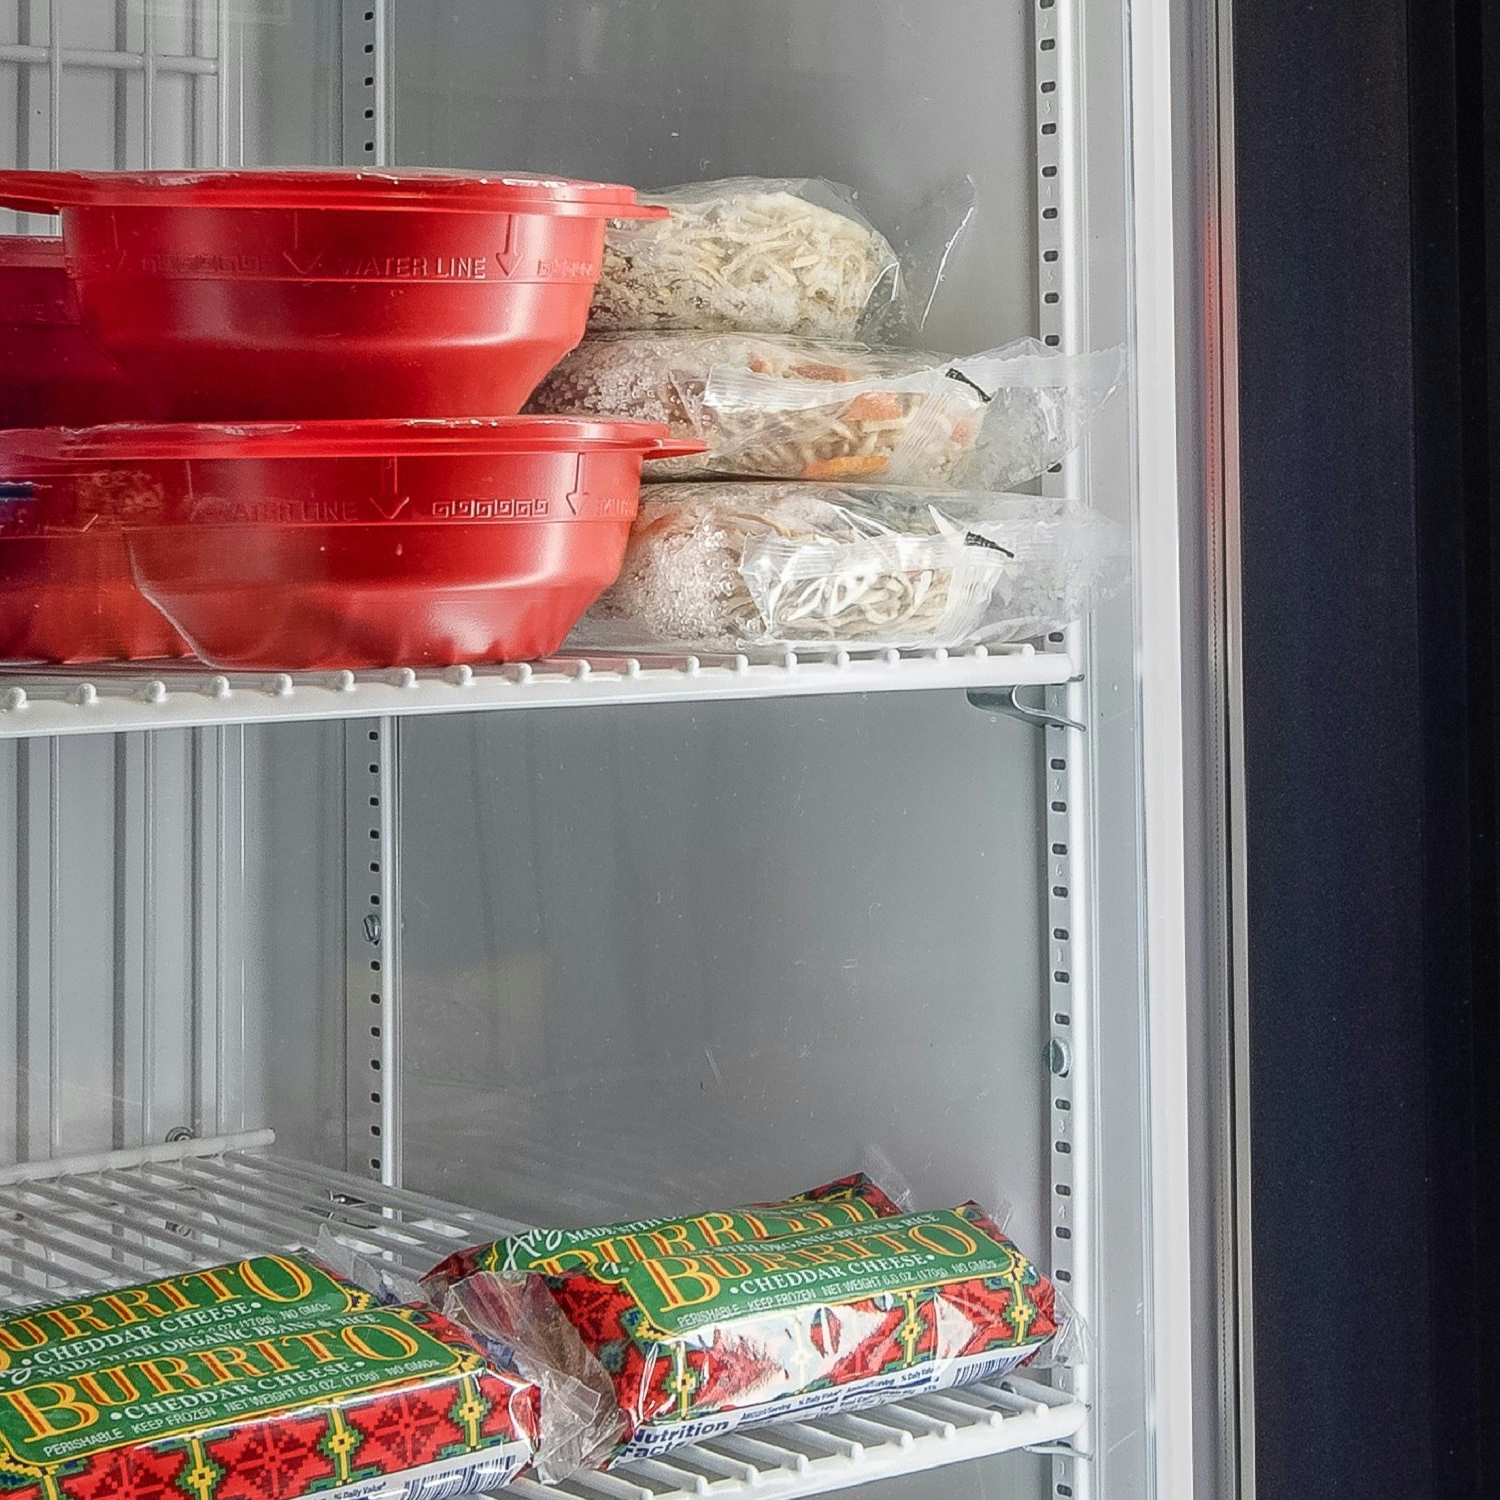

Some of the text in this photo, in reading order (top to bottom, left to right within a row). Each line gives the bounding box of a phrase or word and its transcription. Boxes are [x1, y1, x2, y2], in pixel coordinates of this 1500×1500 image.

[435, 257, 485, 279] LINE
[644, 1218, 979, 1313] BURRITO
[739, 1252, 928, 1296] CHEDDAR CHEESE
[676, 1276, 882, 1328] PERISHABLE KEEP FROZEN NET WEIGHT
[33, 1301, 250, 1366] CHEDDAR CHEESE
[40, 1313, 381, 1378] MADE ORGANIC BEANS RICE
[124, 1361, 351, 1421] CHEDDAR CHEESE
[42, 1388, 298, 1457] PERISHABLE KEEP FROZEN NET WEIGHT
[629, 1418, 729, 1450] Nutrition
